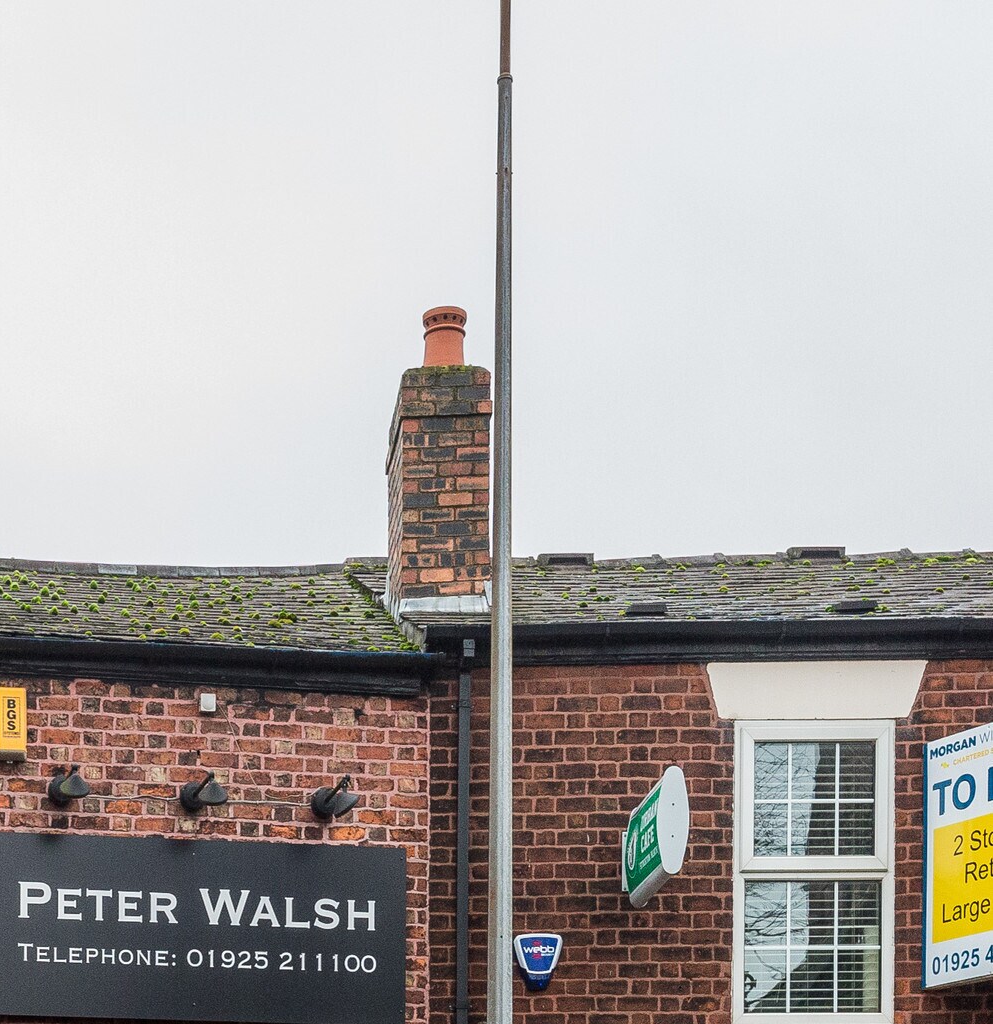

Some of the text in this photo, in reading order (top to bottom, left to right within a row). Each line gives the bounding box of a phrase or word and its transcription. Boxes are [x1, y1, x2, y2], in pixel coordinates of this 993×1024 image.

[7, 699, 16, 730] BGS
[929, 736, 977, 760] MORGAN
[953, 748, 990, 766] CHARTERED
[932, 773, 977, 816] TO
[953, 834, 964, 857] 2
[17, 881, 377, 932] PETER WALSH
[942, 898, 991, 924] Large
[17, 942, 377, 974] TELEPHONE: 01925 211100
[523, 945, 555, 954] webb
[932, 947, 980, 976] 01925
